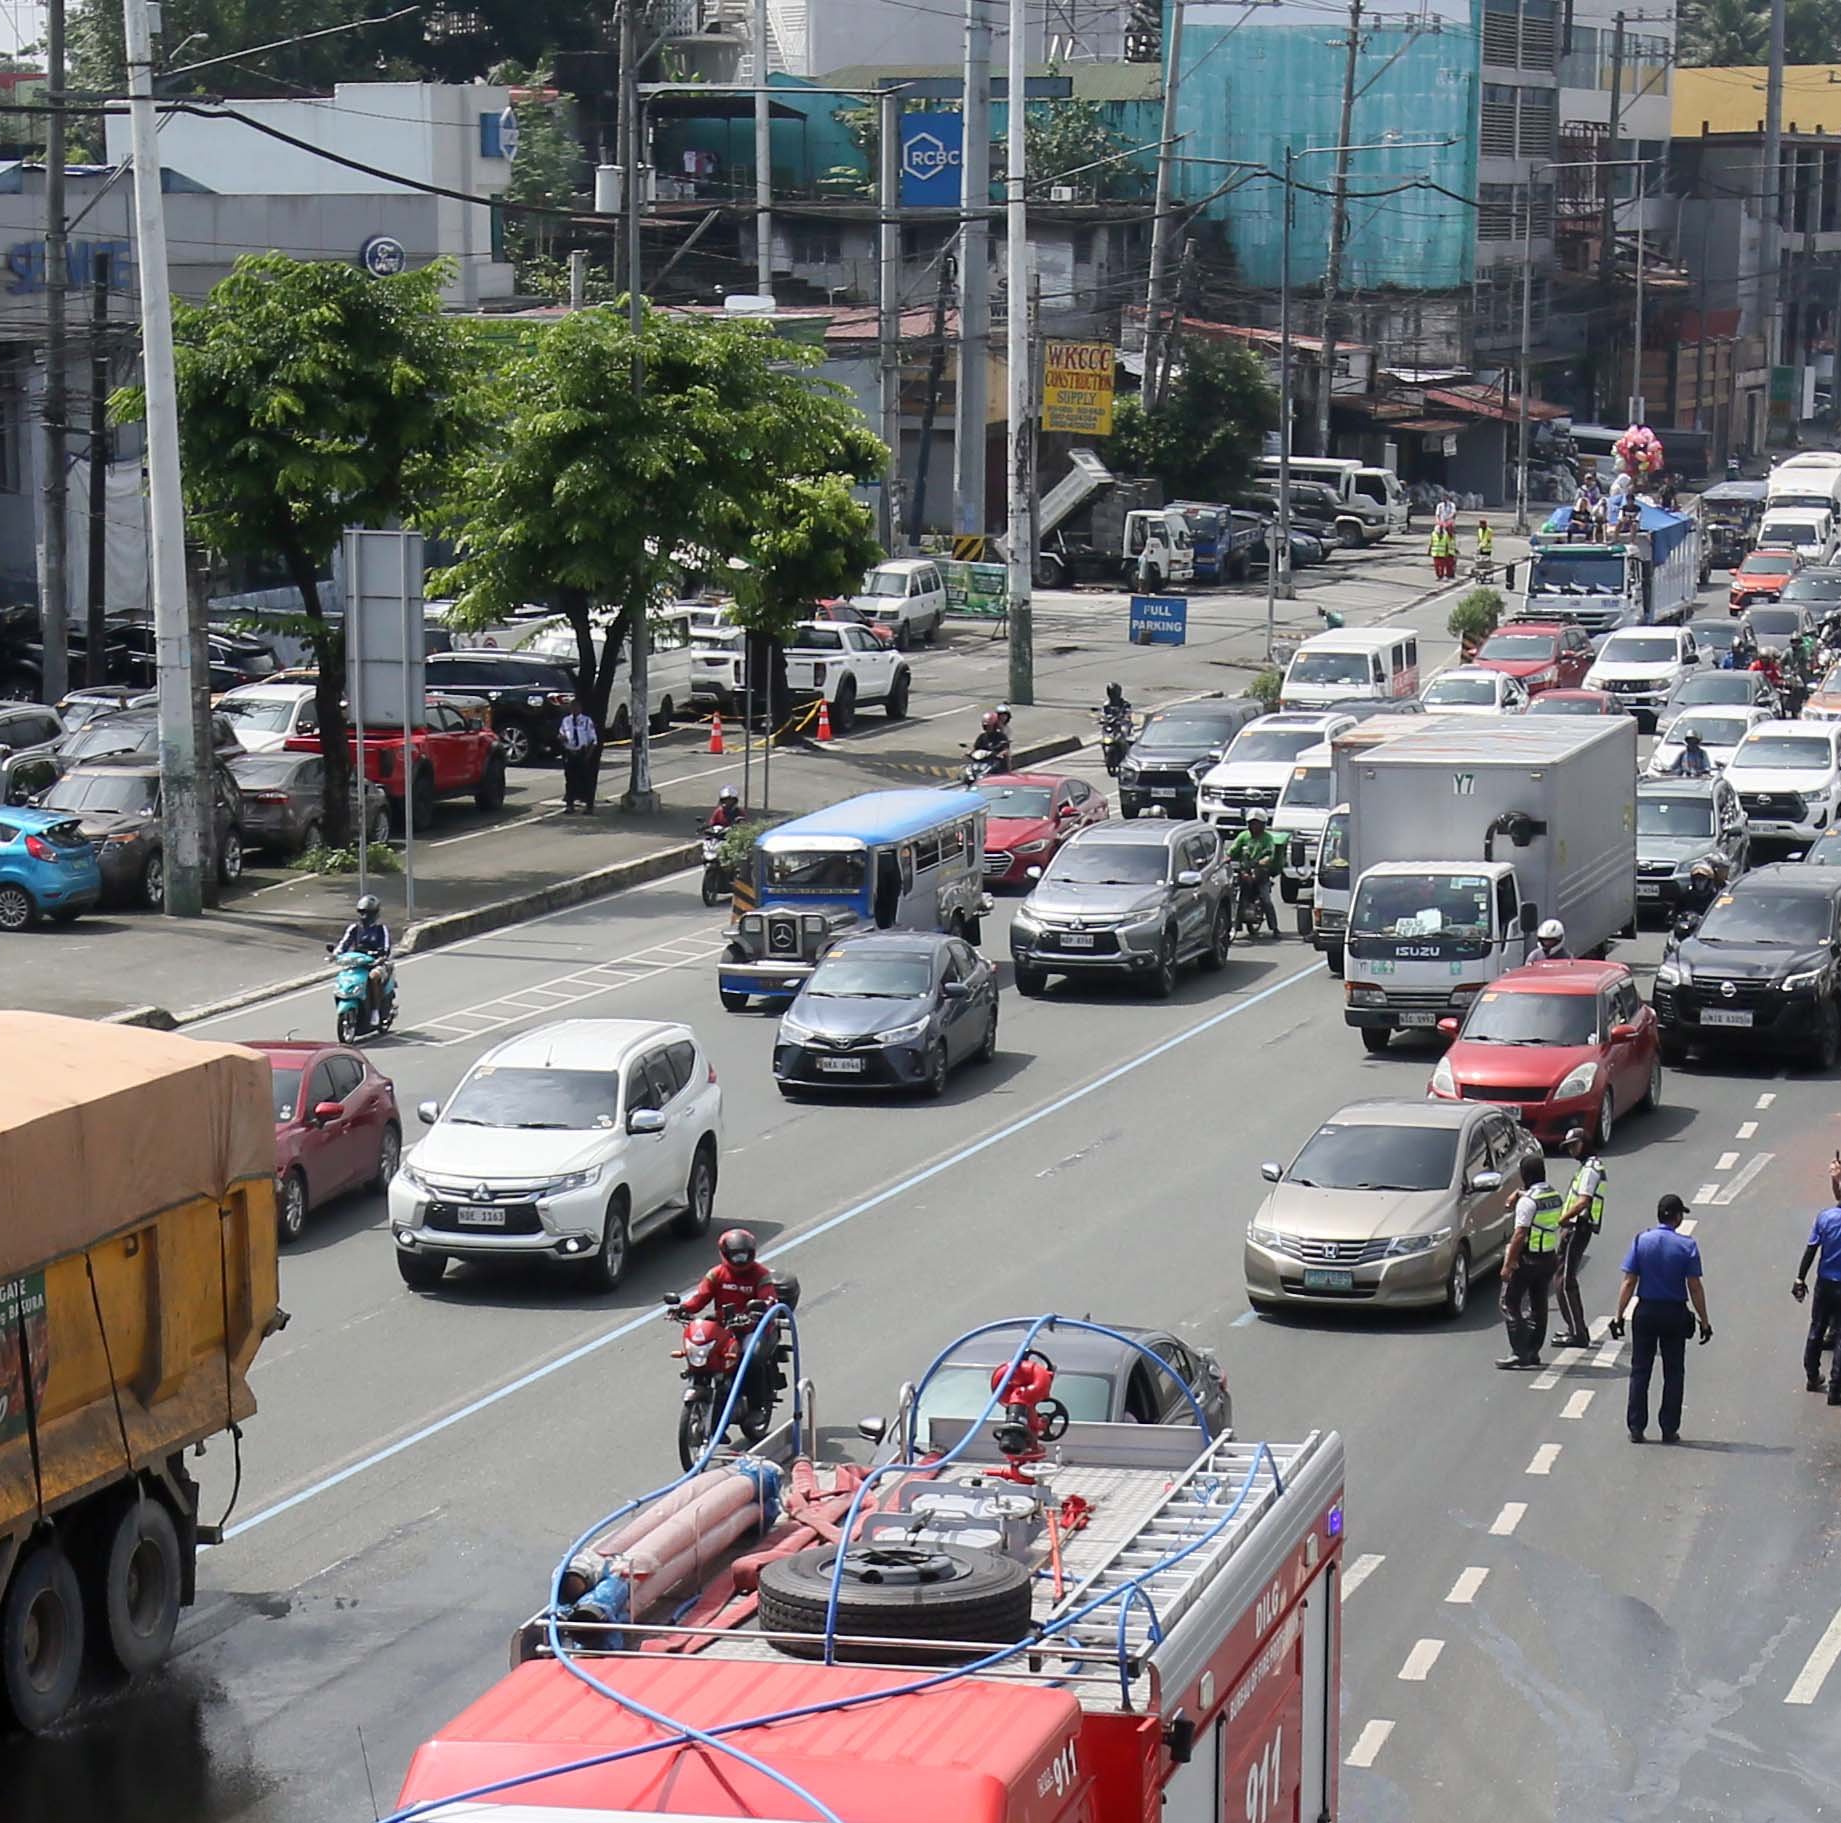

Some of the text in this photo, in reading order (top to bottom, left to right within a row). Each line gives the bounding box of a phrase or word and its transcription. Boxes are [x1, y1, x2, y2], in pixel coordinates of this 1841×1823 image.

[912, 150, 960, 166] RCBC
[1056, 390, 1097, 405] SUPPLY
[1143, 605, 1173, 617] FULL
[1131, 620, 1182, 633] PARKING
[1454, 774, 1474, 792] Y7
[1395, 945, 1441, 957] ISUZU
[1256, 1580, 1279, 1639] DILG
[1053, 1739, 1077, 1797] 911
